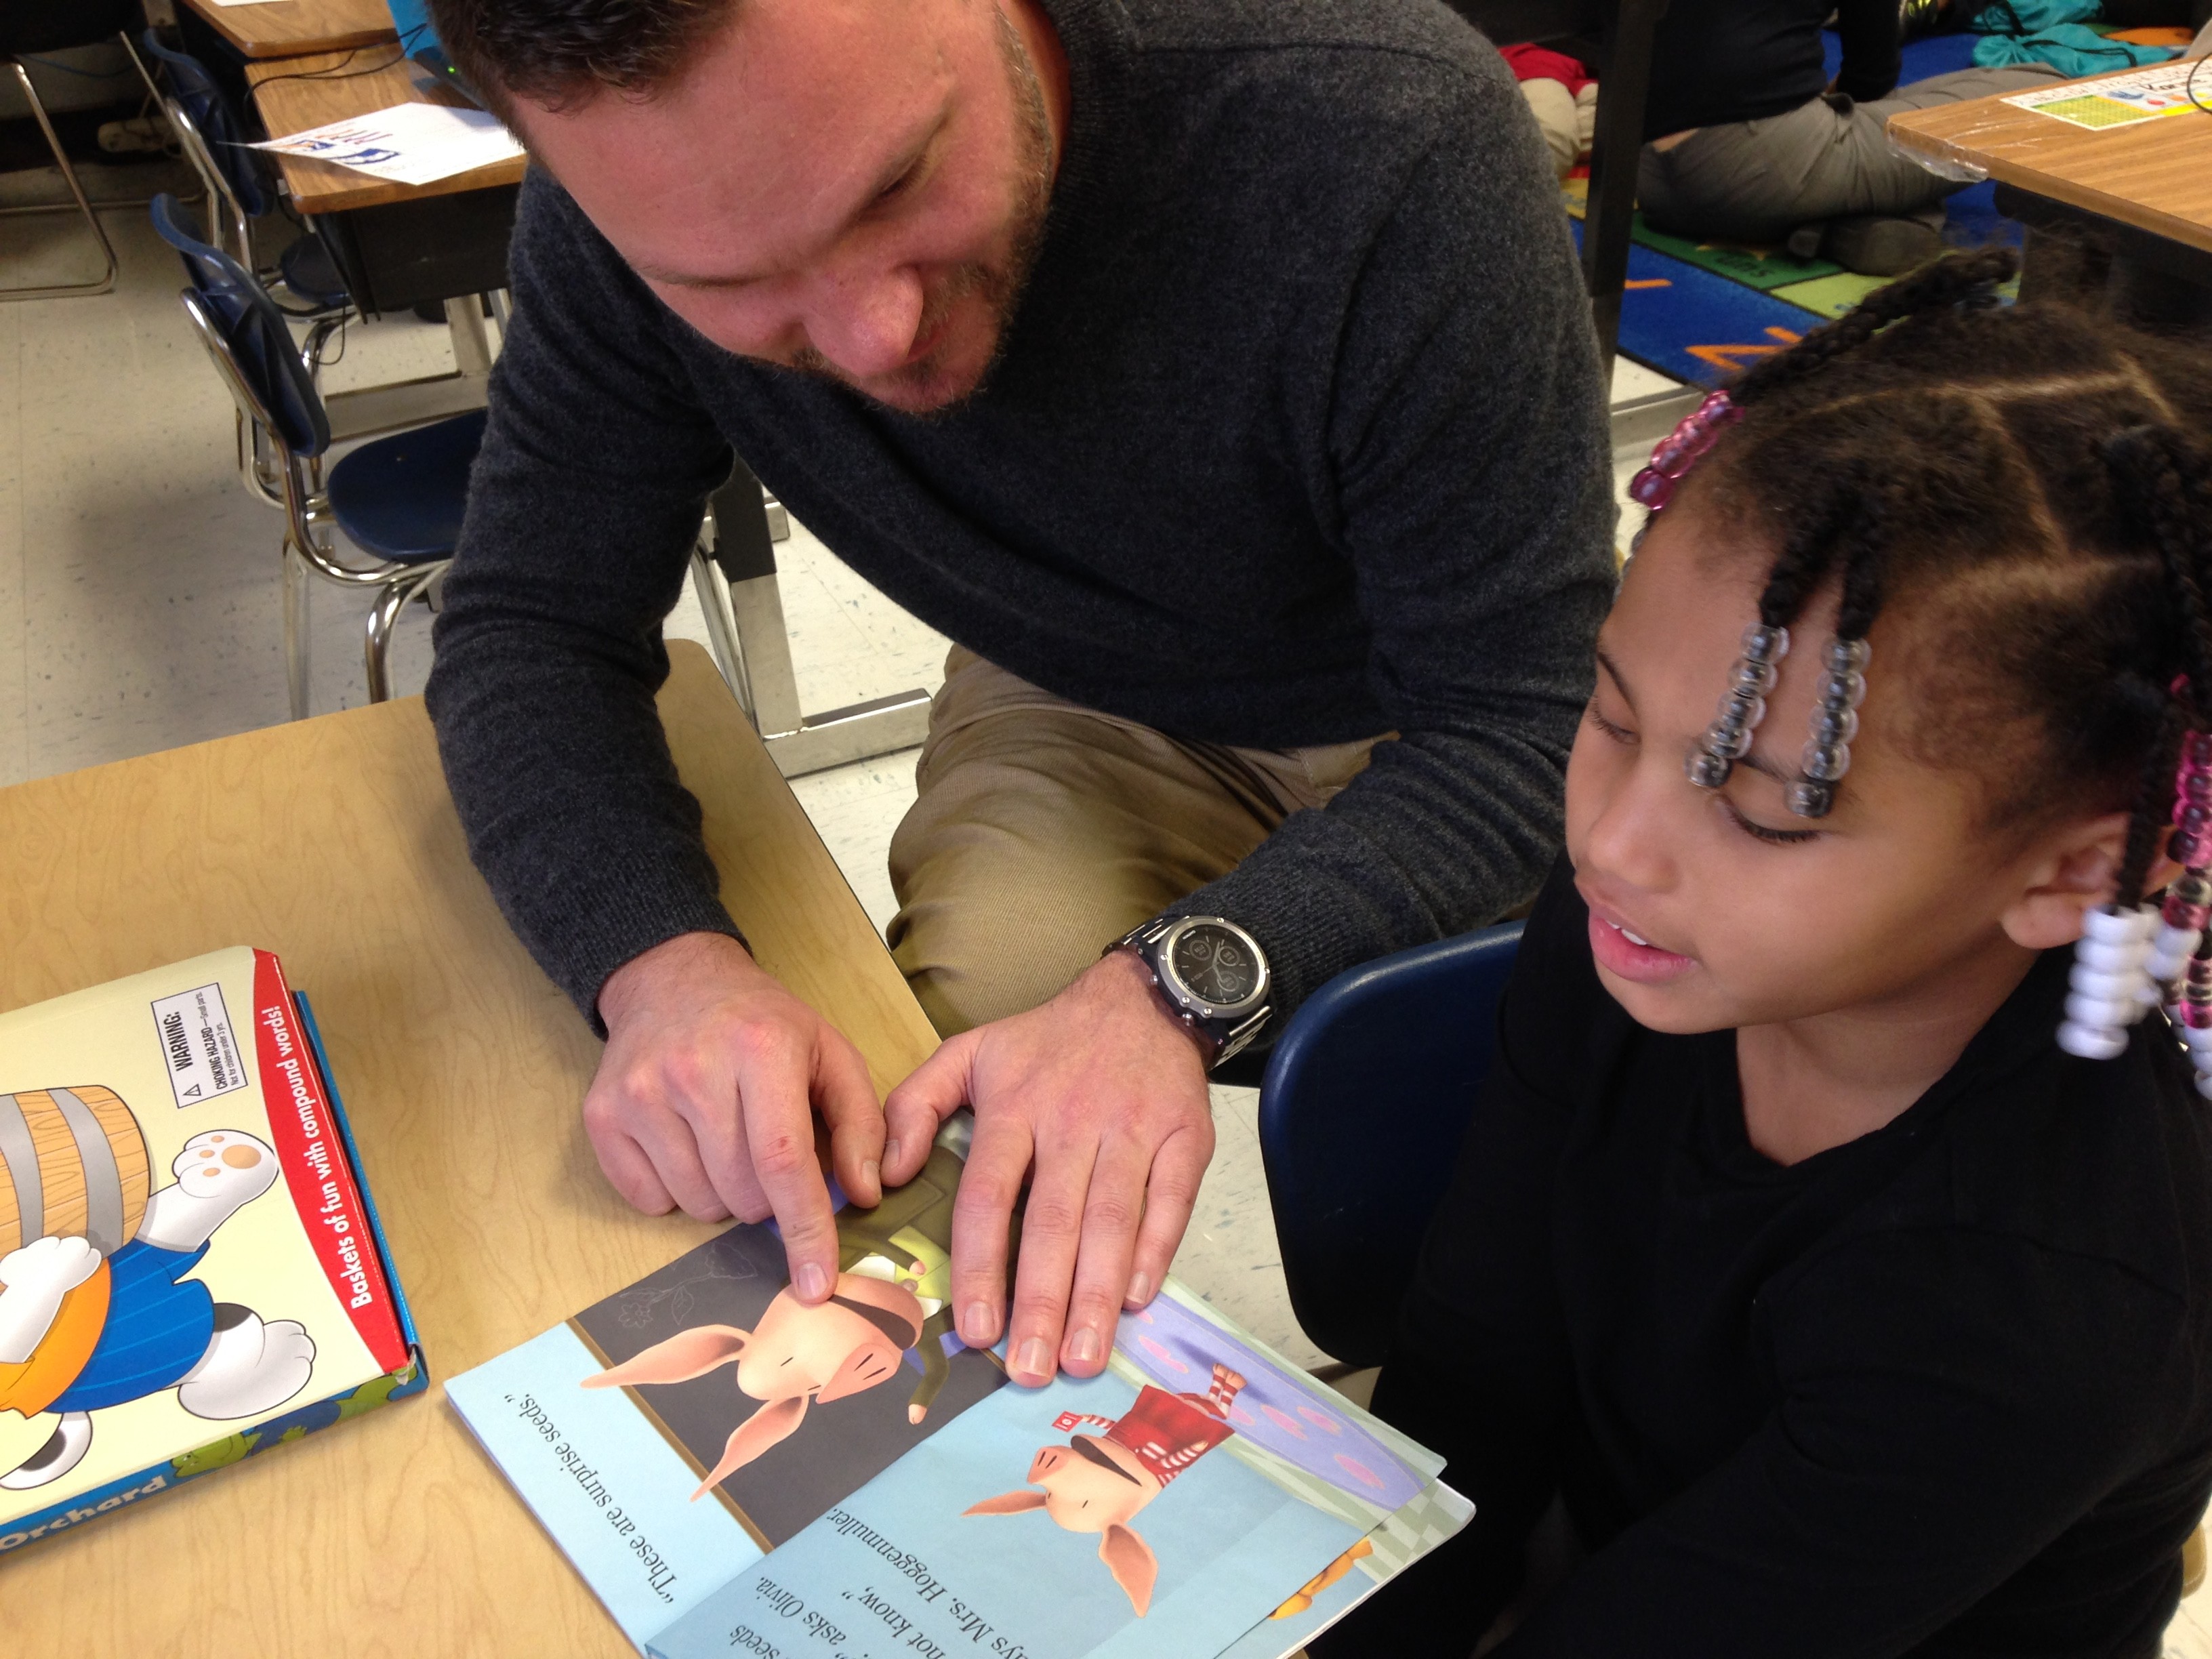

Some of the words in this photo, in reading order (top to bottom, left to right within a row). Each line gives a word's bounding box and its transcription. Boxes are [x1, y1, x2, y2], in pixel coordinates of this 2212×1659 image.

[163, 1011, 194, 1071] WARNING:
[262, 1006, 293, 1057] words!
[208, 1056, 228, 1090] CHOKING
[224, 1048, 235, 1067] children
[230, 1076, 239, 1086] Not
[276, 1058, 320, 1139] compound
[303, 1141, 332, 1181] with
[320, 1181, 343, 1213] fun
[323, 1214, 350, 1233] of
[337, 1235, 373, 1309] Baskets
[555, 1442, 612, 1508] surprise
[0, 1475, 167, 1551] Orchard
[607, 1507, 636, 1536] are
[826, 1508, 947, 1603] Hoggenmuller.
[756, 1577, 804, 1618] Olivia.
[802, 1611, 846, 1645] asks
[949, 1597, 994, 1643] Mrs.
[906, 1631, 946, 1659] not
